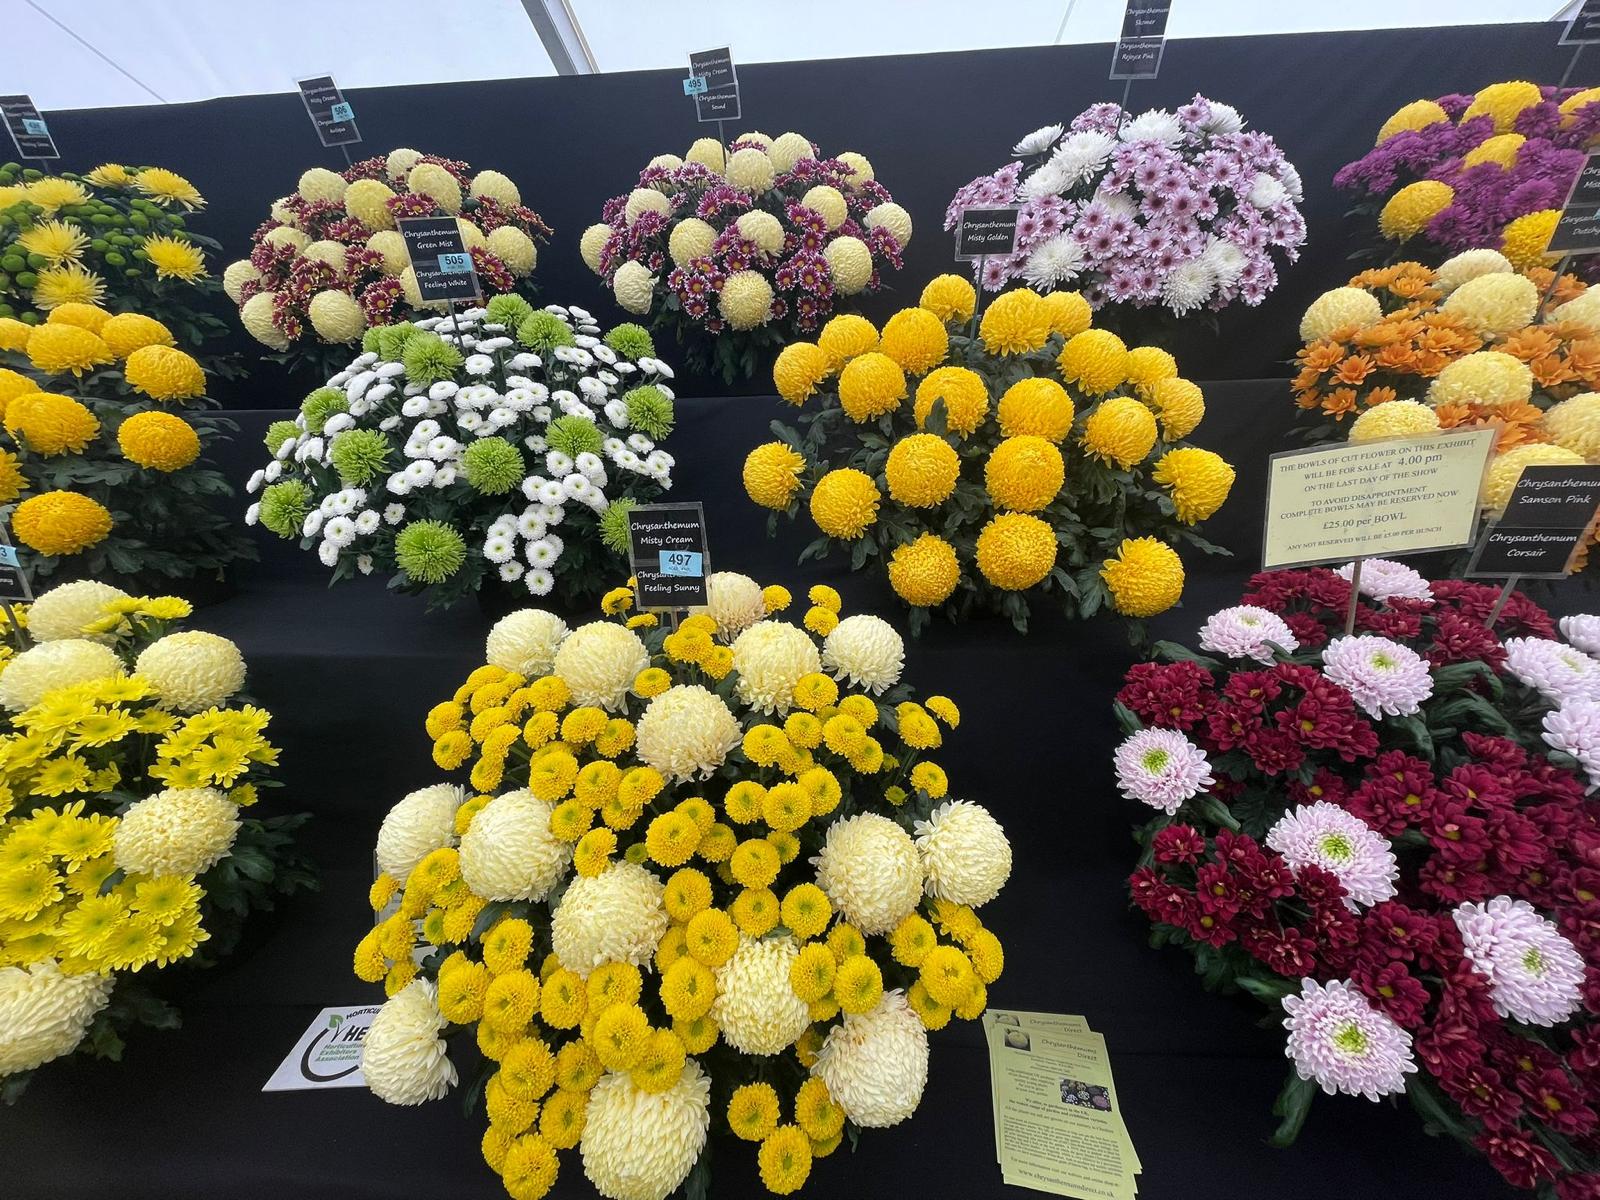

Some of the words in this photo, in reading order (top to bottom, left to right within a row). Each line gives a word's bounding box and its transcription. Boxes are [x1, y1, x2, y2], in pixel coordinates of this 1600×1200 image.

[1120, 42, 1161, 50] Chrysanthemum
[693, 58, 729, 69] Chrysanthemum
[688, 79, 702, 88] 495
[698, 94, 736, 102] Chrysanthemum
[963, 221, 1016, 230] Chrysanthemum
[404, 229, 458, 238] Chrysanthemum
[968, 234, 985, 242] Misty
[445, 256, 464, 264] 505
[1280, 464, 1296, 472] THE
[1298, 460, 1326, 470] BOWLS
[1341, 454, 1358, 463] CUT
[1360, 449, 1396, 459] FLOWER
[1398, 446, 1412, 454] ON
[1415, 444, 1434, 452] THIS
[1436, 439, 1476, 449] EXHIBIT
[1304, 471, 1324, 480] WILL
[1339, 467, 1355, 475] FOR
[1357, 463, 1380, 472] SALE
[1397, 455, 1422, 466] 4.00
[1424, 454, 1442, 464] pm
[1318, 482, 1335, 490] THE
[1336, 478, 1358, 488] LAST
[1359, 475, 1378, 484] DAY
[1393, 472, 1410, 480] THE
[1412, 468, 1438, 476] SHOW
[1323, 497, 1350, 505] AVOID
[1351, 486, 1427, 501] DISAPPOINTMENT
[1520, 495, 1561, 504] Samson
[1566, 494, 1592, 504] Pink
[1280, 508, 1324, 519] COMPLETE
[1325, 504, 1354, 513] BOWLS
[1356, 500, 1377, 508] MAY
[1390, 493, 1435, 504] RESERVED
[1436, 490, 1459, 498] NOW
[1322, 519, 1354, 530] £25.00
[1356, 518, 1372, 528] per
[1374, 512, 1407, 523] BOWL
[640, 537, 663, 546] Misty
[665, 536, 693, 544] Cream
[1318, 538, 1354, 546] RESERVED
[1416, 526, 1442, 534] BUNCH
[1489, 533, 1577, 544] Chrysanthemum
[1507, 548, 1546, 557] Corsair
[668, 554, 692, 566] 497
[644, 584, 672, 593] Feeling
[674, 584, 700, 592] Sunny
[342, 1025, 370, 1042] HE
